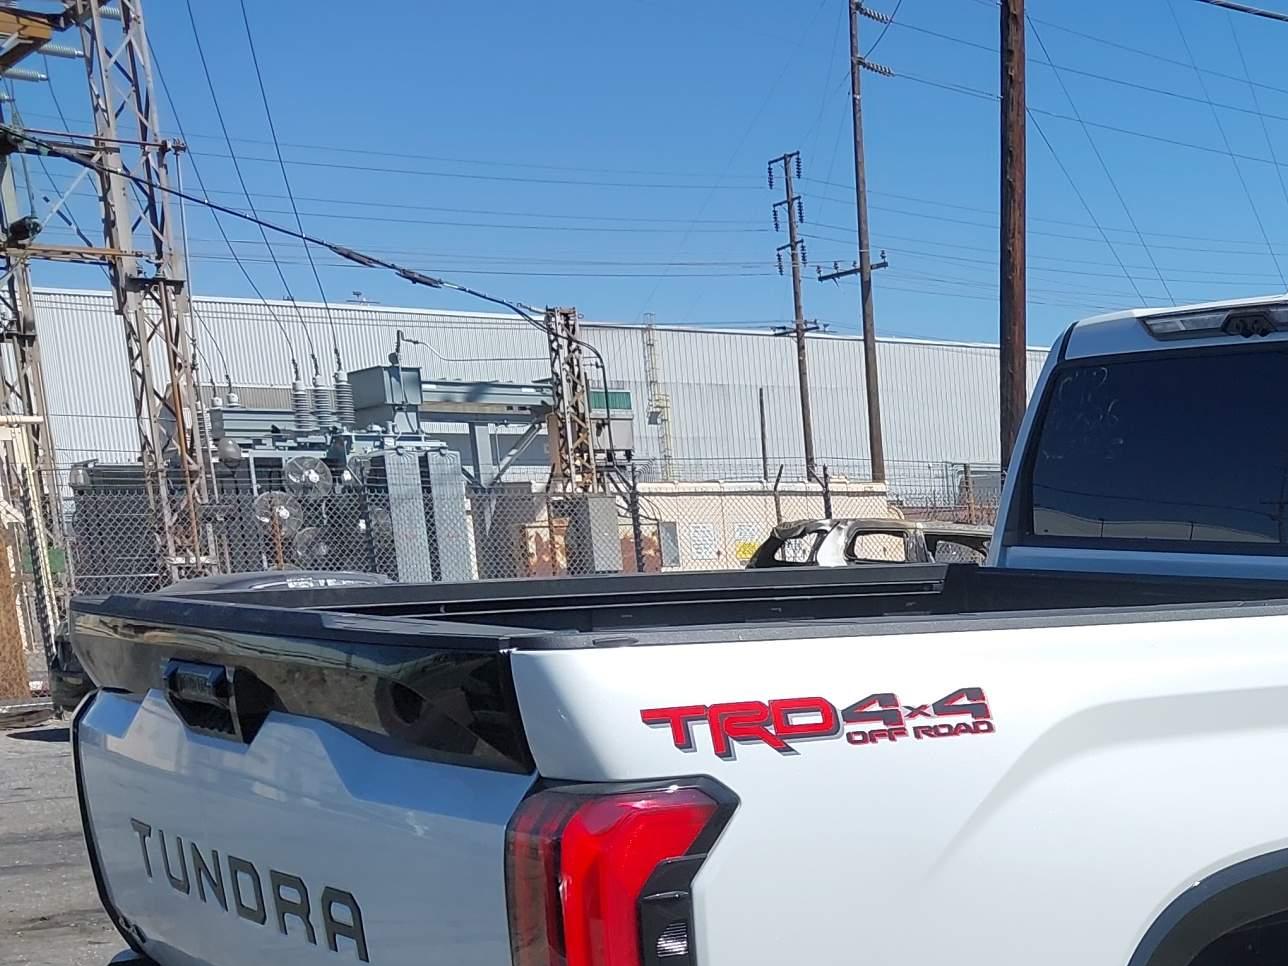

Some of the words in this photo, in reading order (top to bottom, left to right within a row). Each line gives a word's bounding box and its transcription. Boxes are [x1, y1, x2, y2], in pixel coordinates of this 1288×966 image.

[640, 696, 845, 762] TRD
[842, 687, 994, 727] 4x4
[846, 728, 909, 746] OFF
[913, 720, 996, 741] ROAD
[130, 817, 370, 964] TUNDRA
